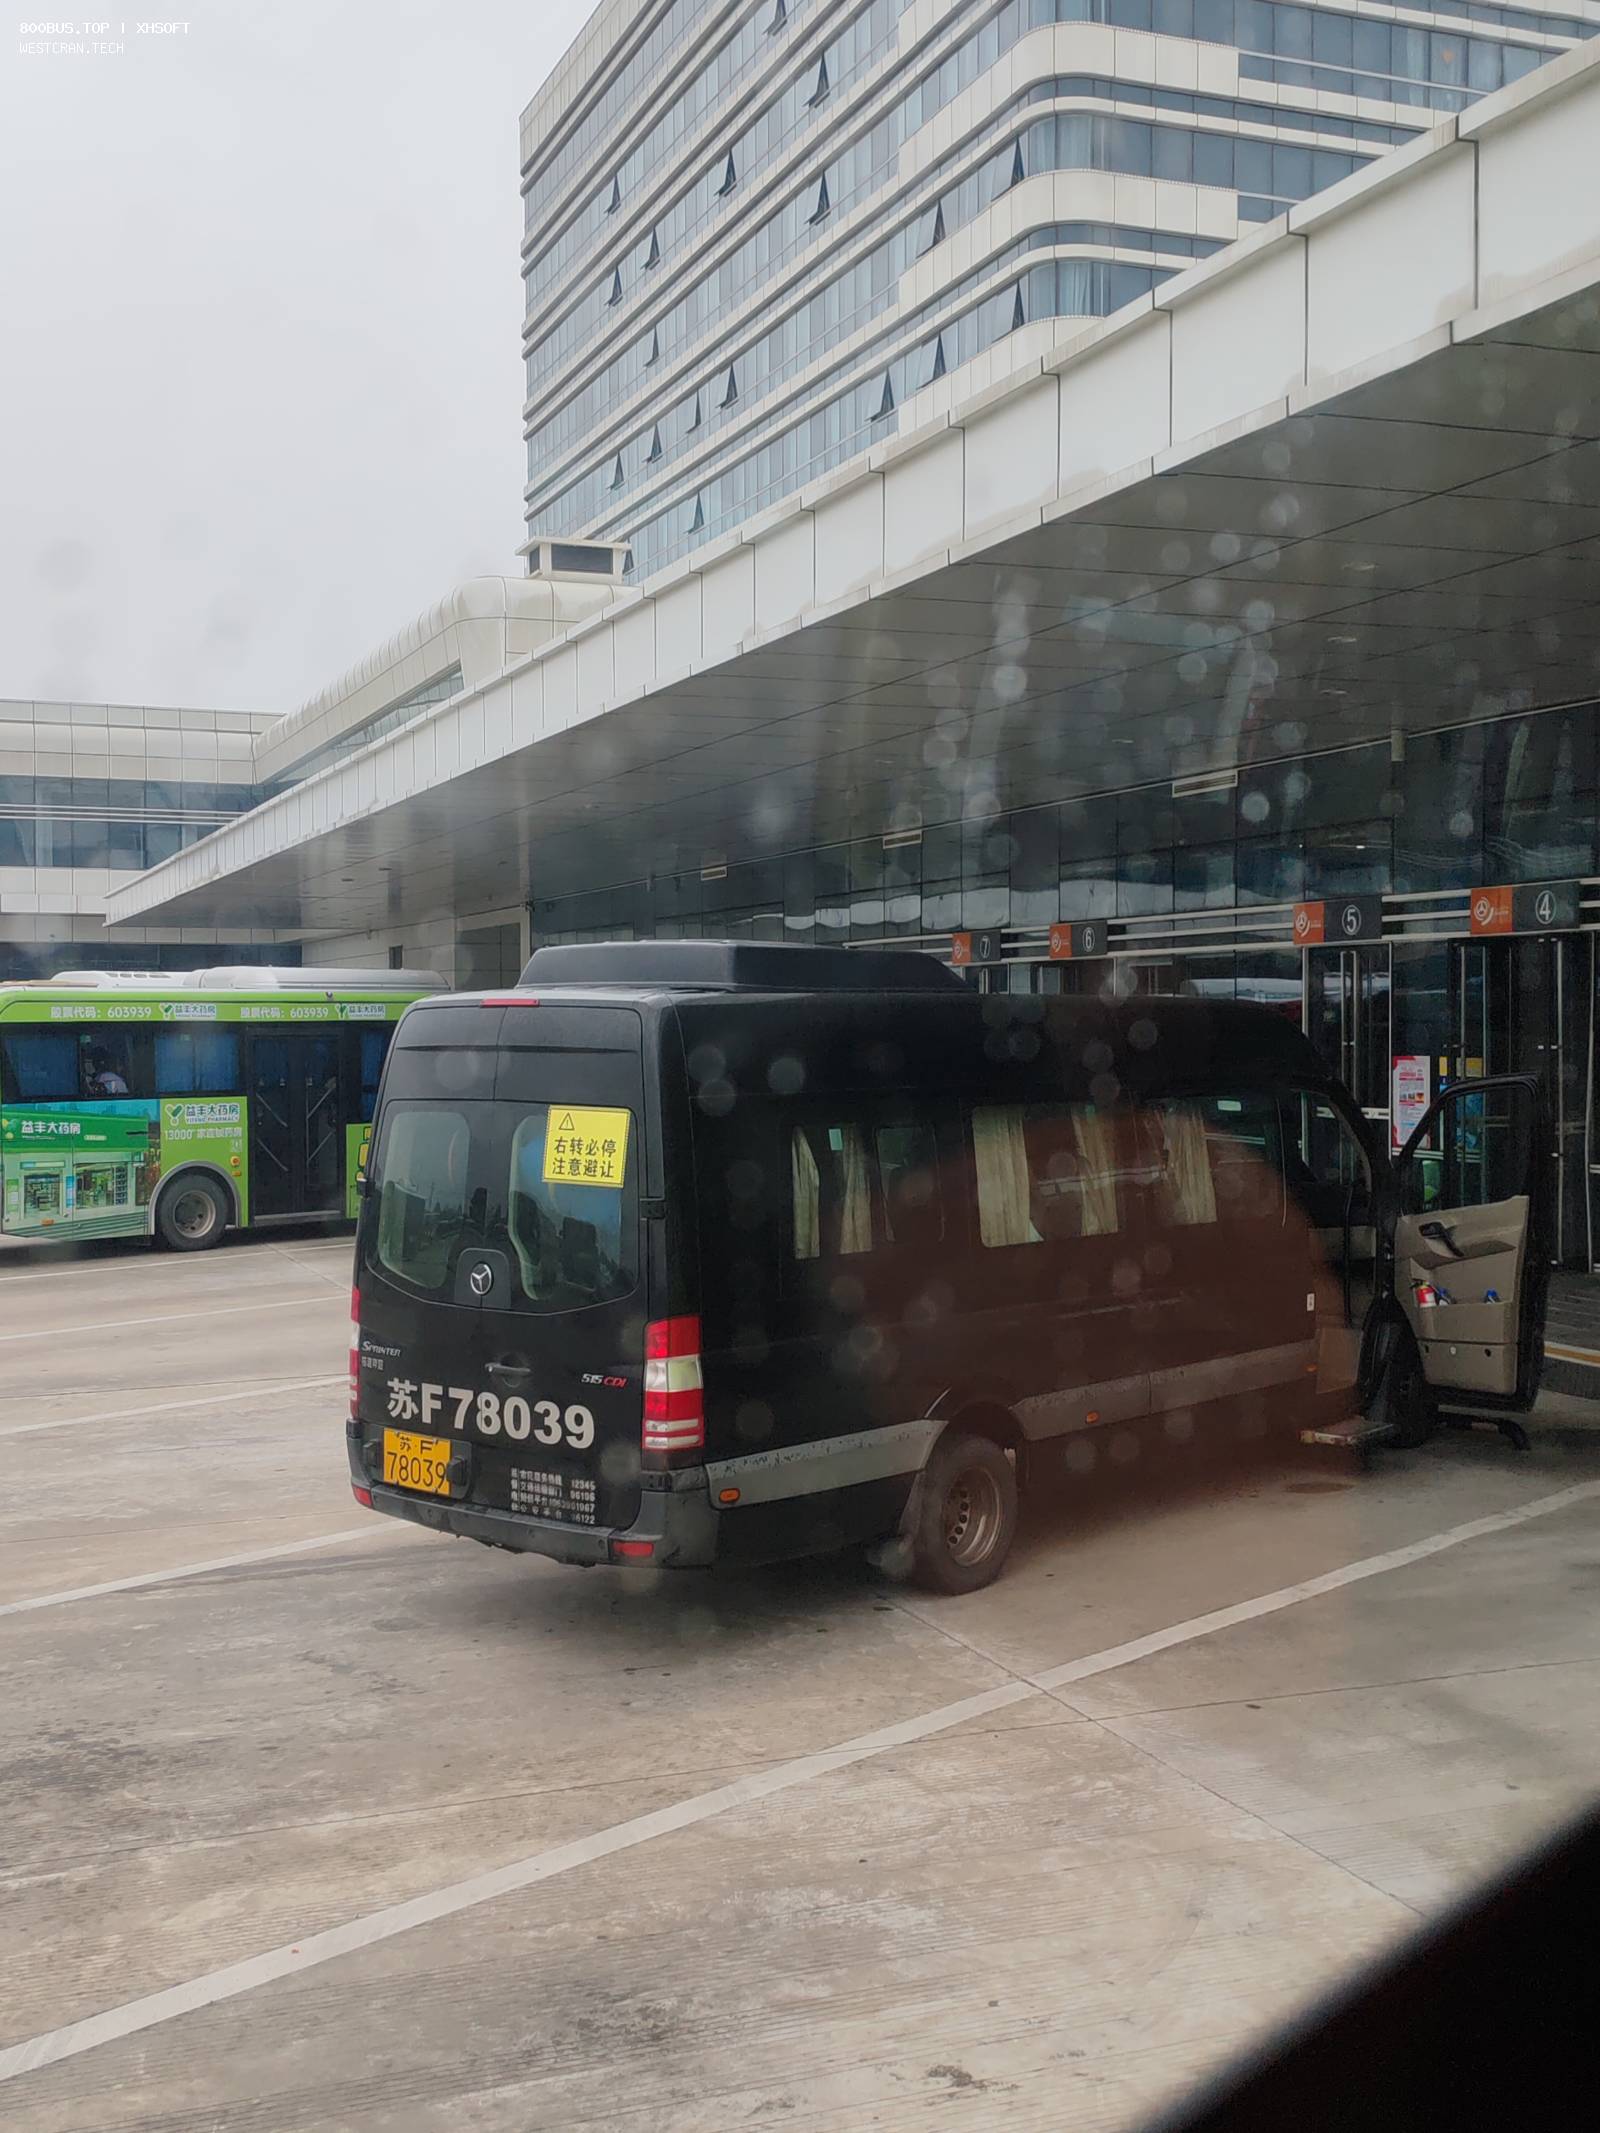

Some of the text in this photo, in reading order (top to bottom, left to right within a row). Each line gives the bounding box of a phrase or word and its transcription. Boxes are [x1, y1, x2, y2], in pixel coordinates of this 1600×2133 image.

[186, 1104, 240, 1117] 益丰大药房
[21, 1120, 81, 1135] 益丰大药房
[554, 1136, 616, 1158] 右转必停
[552, 1157, 614, 1178] 注意避让
[581, 1373, 627, 1388] 515 CDI
[387, 1377, 596, 1450] 苏F78039
[387, 1451, 446, 1489] 78039
